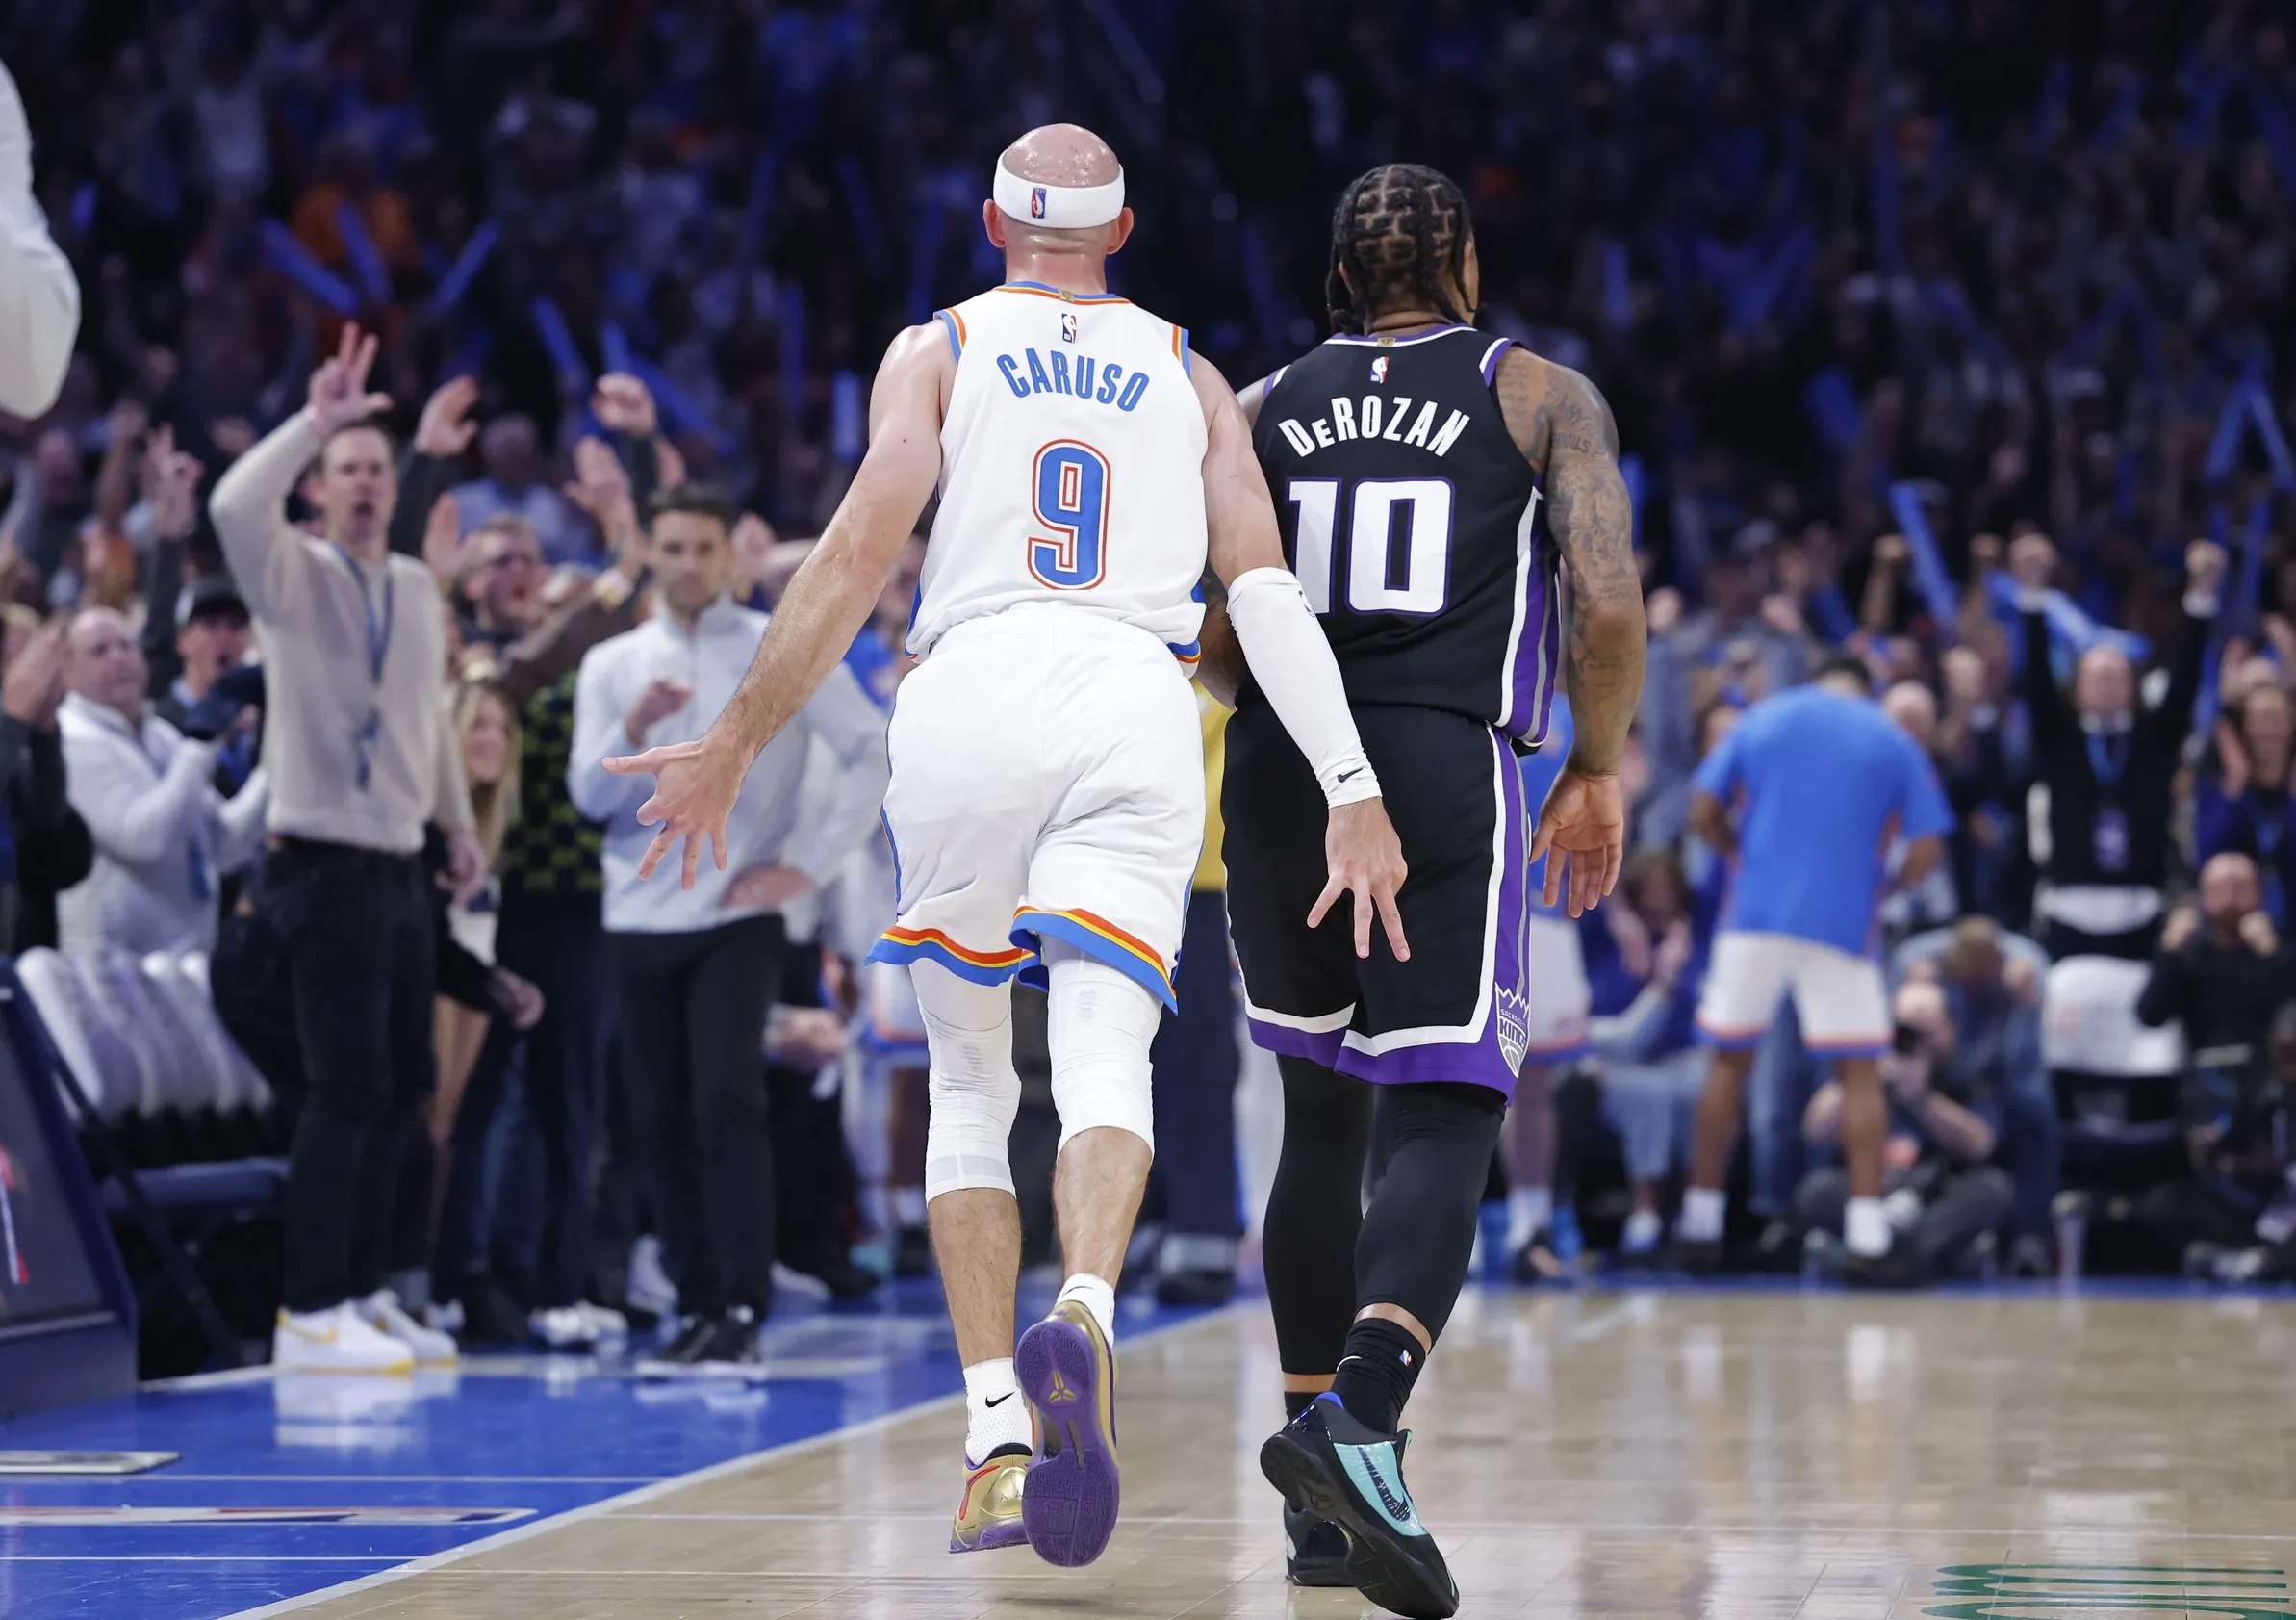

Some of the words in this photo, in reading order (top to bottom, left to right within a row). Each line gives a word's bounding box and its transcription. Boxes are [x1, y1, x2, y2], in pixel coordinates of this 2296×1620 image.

[997, 348, 1150, 412] CARUSO
[1028, 439, 1111, 590] 9
[1285, 476, 1455, 616] 10
